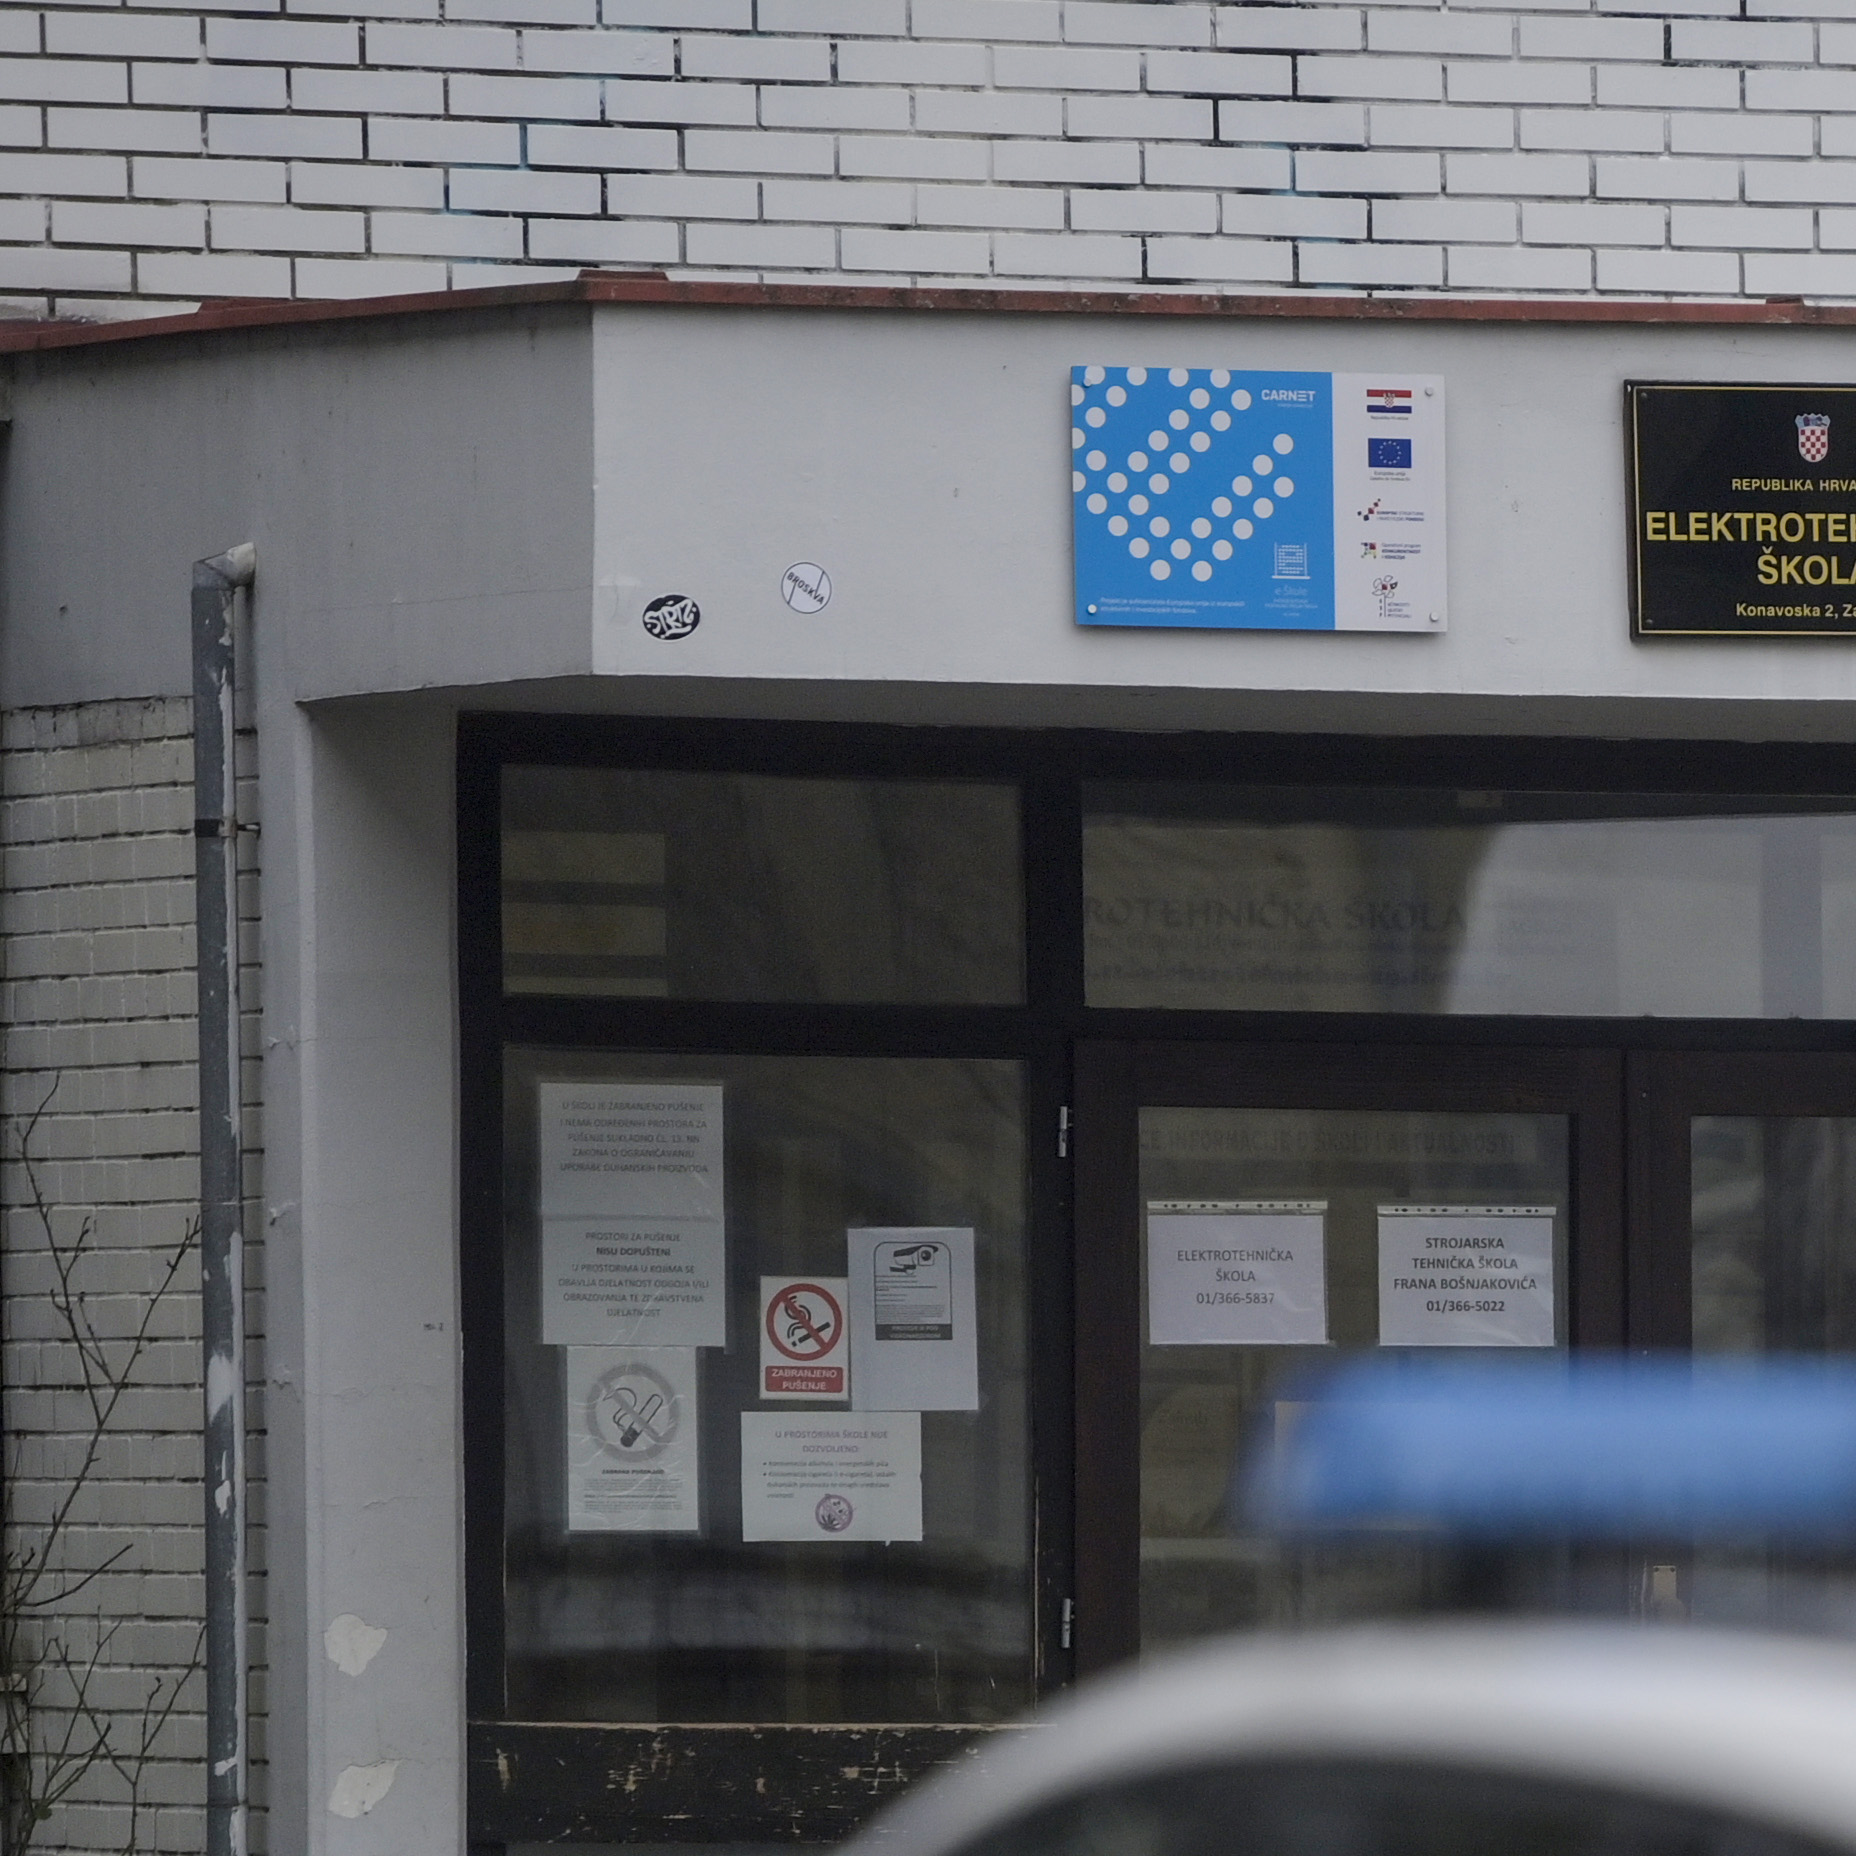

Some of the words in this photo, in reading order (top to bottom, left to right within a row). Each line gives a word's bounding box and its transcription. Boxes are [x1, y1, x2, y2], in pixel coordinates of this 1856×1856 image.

[1261, 389, 1316, 402] CARNET
[1731, 477, 1815, 492] REPUBLIKA
[786, 571, 826, 605] BROSKVA
[1735, 602, 1820, 619] Konavoska
[1824, 603, 1839, 621] 2,
[1425, 1237, 1505, 1250] STROJARSKA
[596, 1247, 617, 1256] NISU
[620, 1246, 671, 1256] DOPUŠTENI
[1176, 1247, 1294, 1262] ELEKTROTEHNIČKA
[1411, 1255, 1476, 1270] TEHNIČKA
[1478, 1256, 1519, 1270] ŠKOLA
[1215, 1268, 1256, 1283] ŠKOLA
[1393, 1278, 1438, 1290] FRANA
[1439, 1276, 1537, 1290] BOŠNJAKOVIĆA
[1196, 1292, 1275, 1305] 01/366-5837
[1426, 1299, 1505, 1314] 01/366-5022
[772, 1368, 837, 1378] ZABRANJENO
[782, 1380, 827, 1390] PUŠENJE
